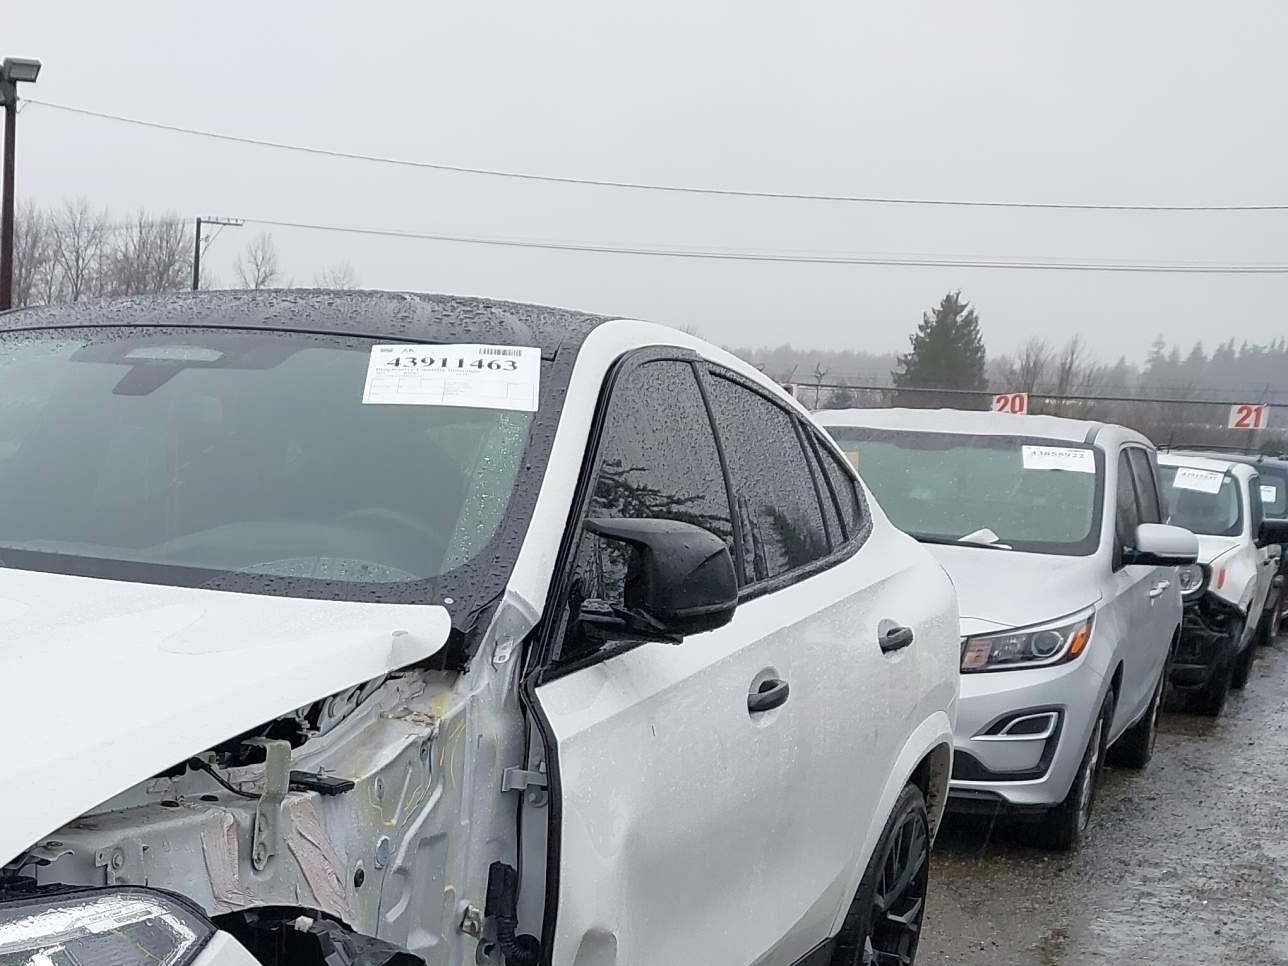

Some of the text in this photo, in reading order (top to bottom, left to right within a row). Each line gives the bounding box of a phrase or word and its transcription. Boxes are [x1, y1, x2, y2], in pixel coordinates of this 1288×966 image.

[386, 355, 519, 372] 43911463
[996, 395, 1025, 414] 20
[1235, 406, 1263, 428] 21
